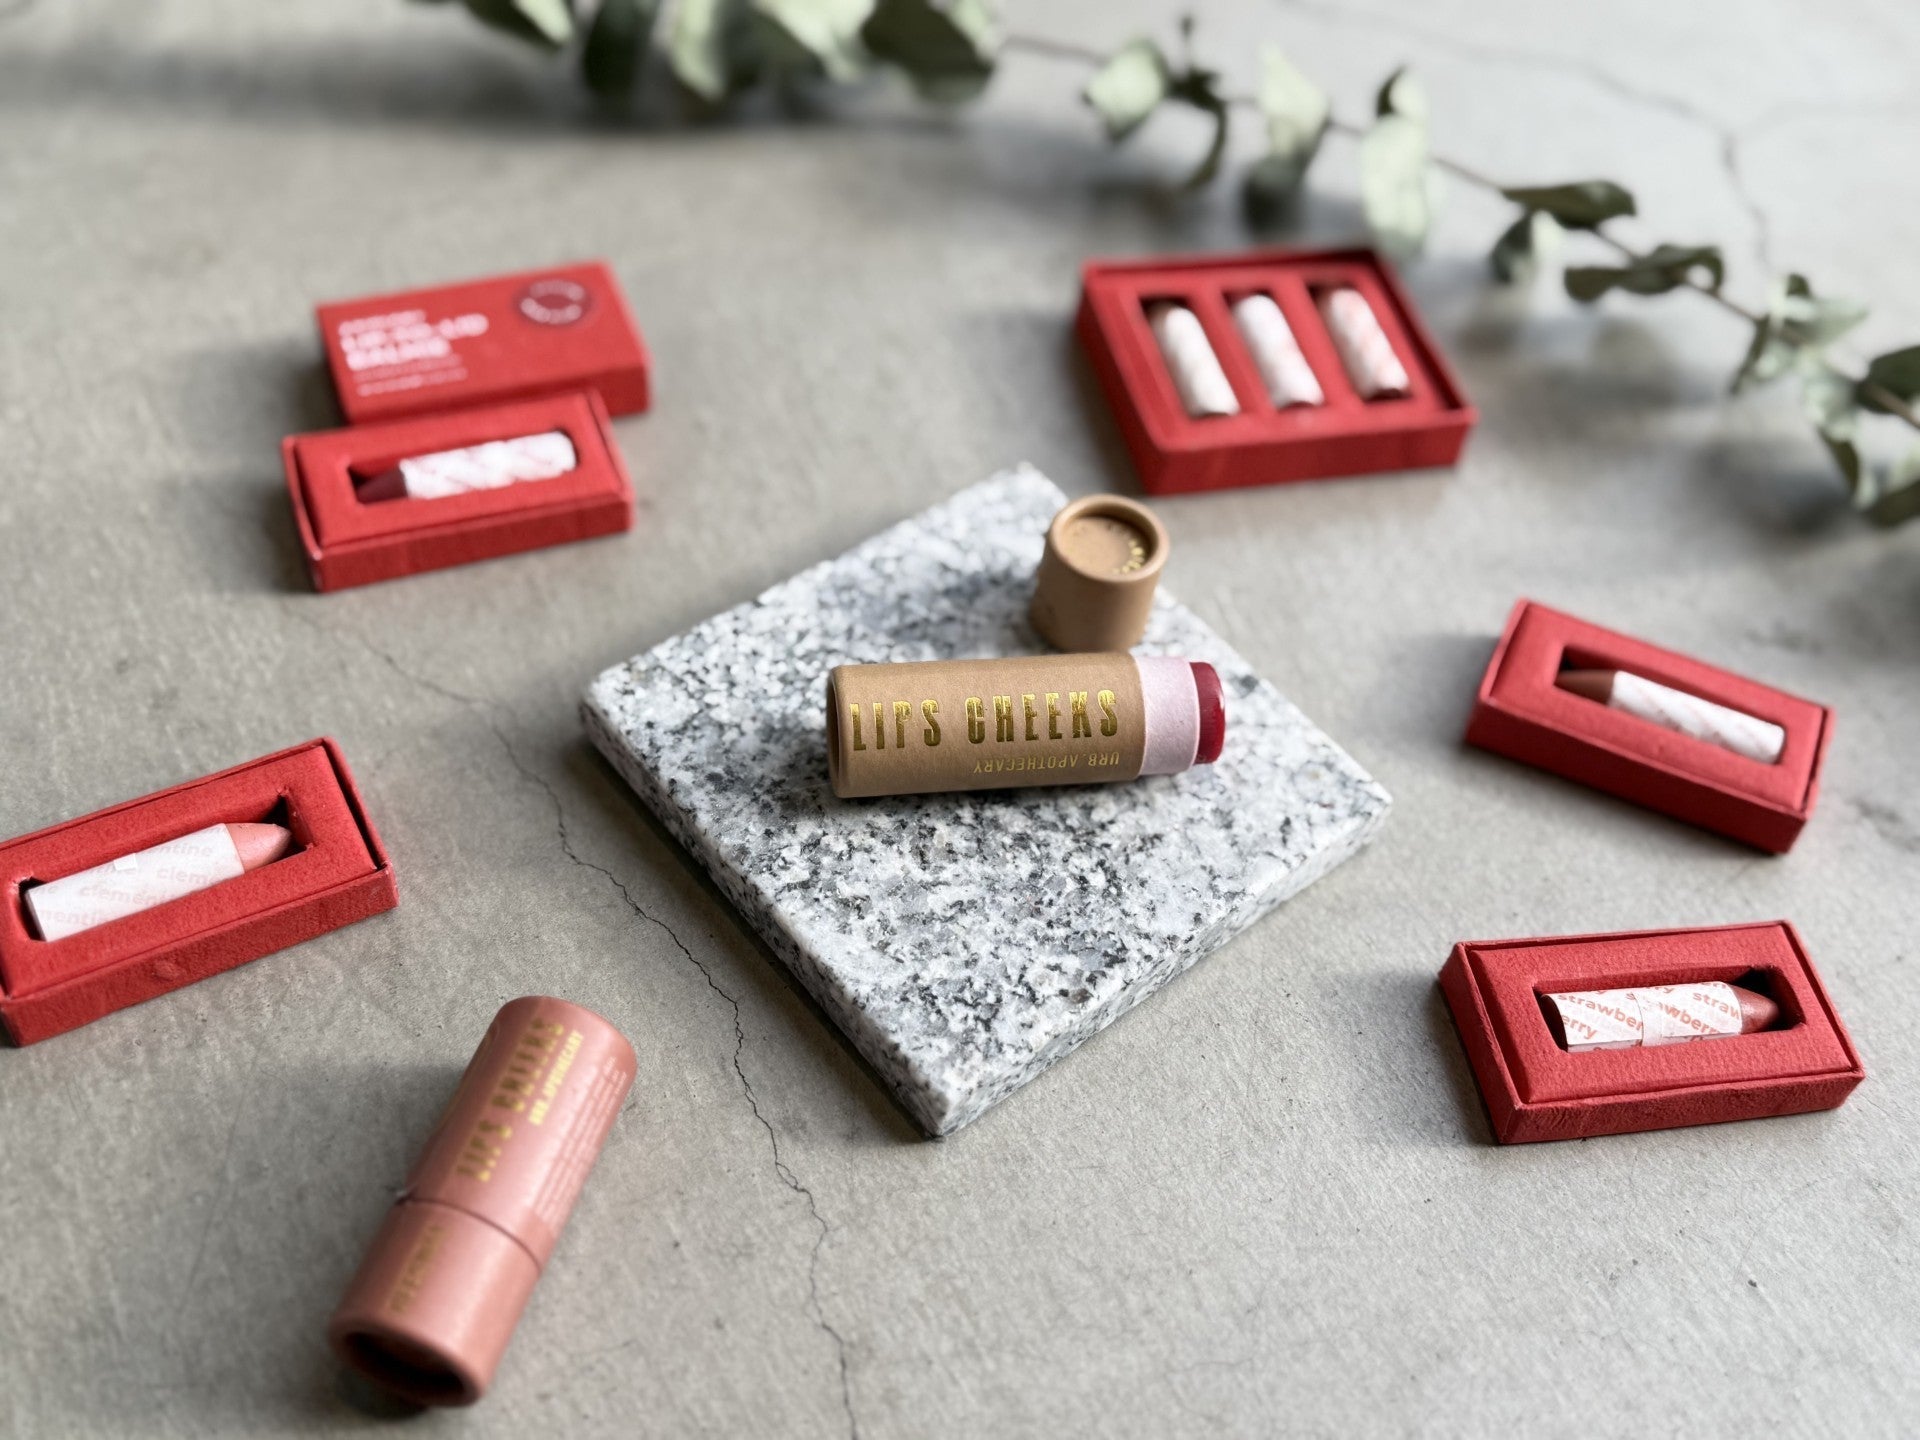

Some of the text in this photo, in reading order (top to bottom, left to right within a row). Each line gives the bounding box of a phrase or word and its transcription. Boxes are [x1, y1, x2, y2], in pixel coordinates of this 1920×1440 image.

[849, 688, 1120, 751] LIPS CHEEKS
[972, 756, 1079, 775] APOTHECARY
